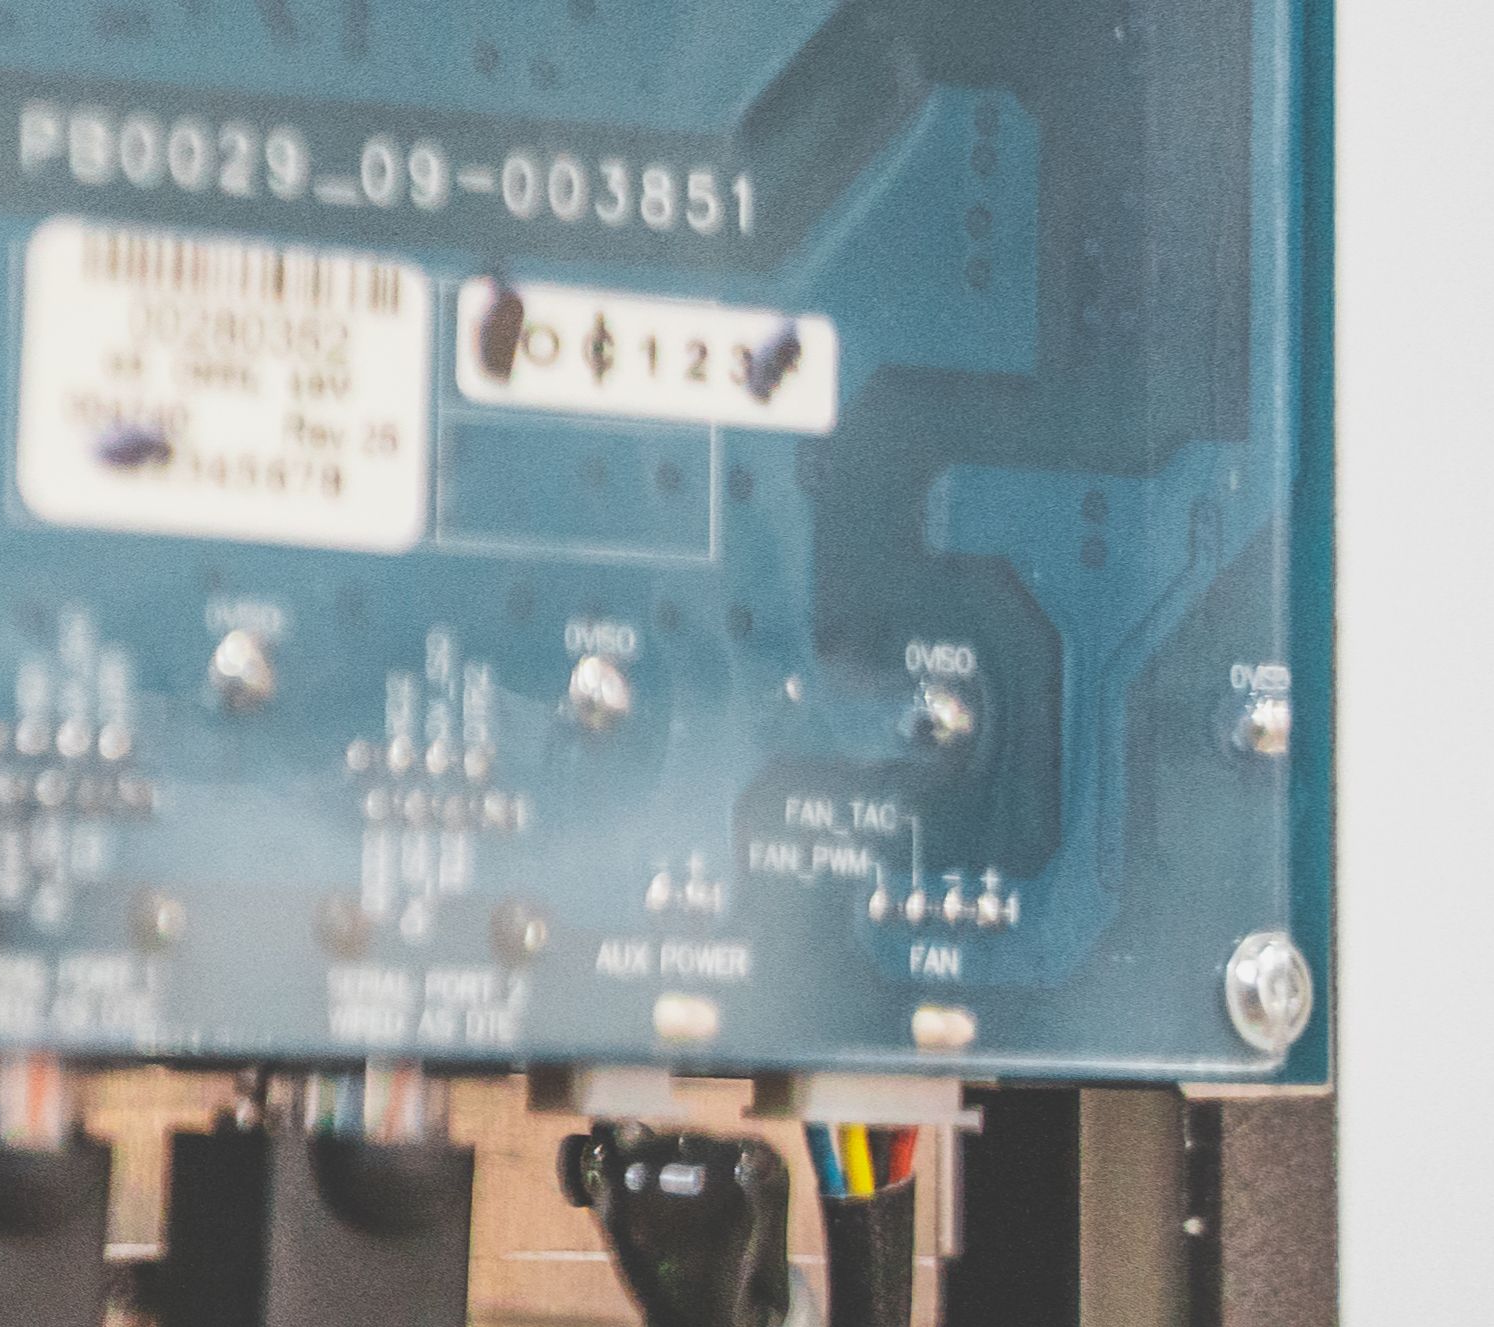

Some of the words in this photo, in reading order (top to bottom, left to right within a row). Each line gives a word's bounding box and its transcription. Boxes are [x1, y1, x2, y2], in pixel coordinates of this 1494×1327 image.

[19, 107, 754, 235] PB0029_09-003851
[785, 797, 897, 835] FAN_TAC
[749, 843, 870, 880] FAN_PWM
[596, 944, 650, 975] AUX
[661, 946, 749, 978] POWER
[910, 947, 961, 978] FAN
